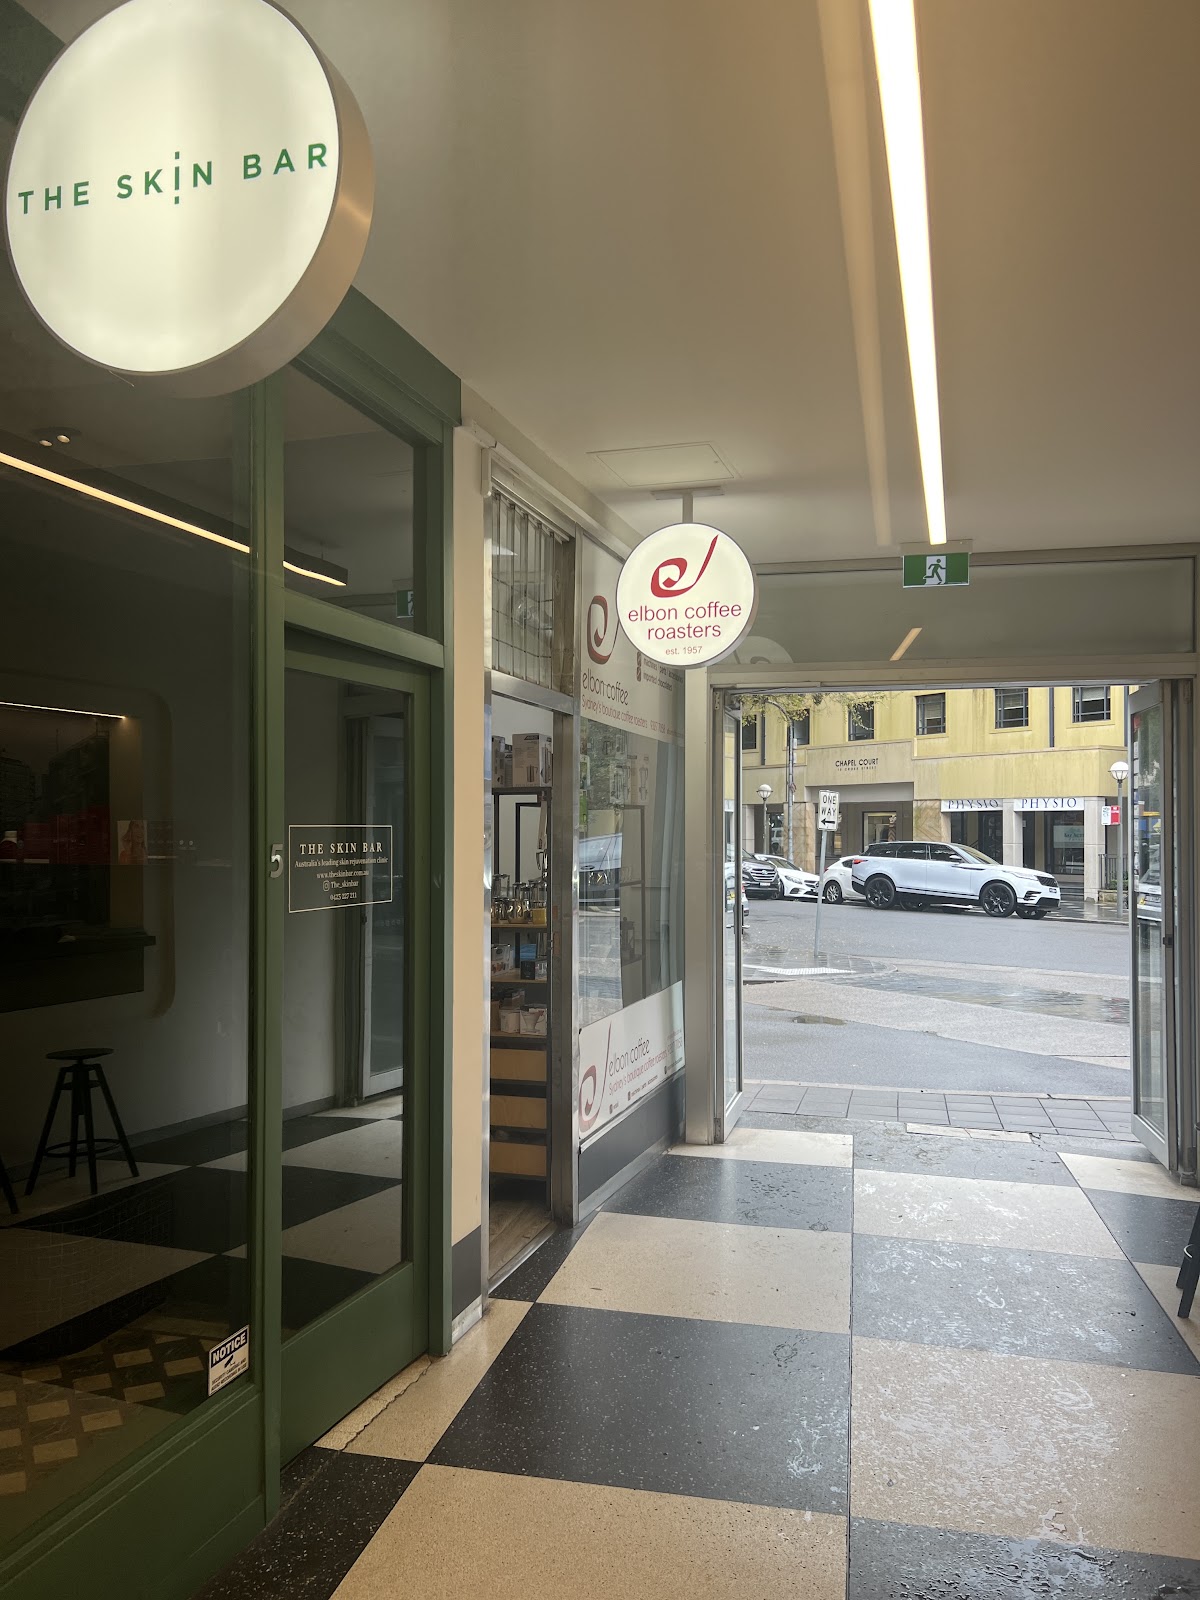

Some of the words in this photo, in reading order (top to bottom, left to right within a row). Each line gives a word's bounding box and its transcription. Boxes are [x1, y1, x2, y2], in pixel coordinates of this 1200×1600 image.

[18, 181, 90, 215] THE
[243, 143, 328, 180] BAR
[628, 605, 678, 622] elbon
[684, 601, 742, 619] coffee
[647, 622, 722, 640] roasters
[665, 647, 681, 656] est.
[683, 645, 703, 654] 1957
[582, 667, 605, 697] elbon
[606, 681, 629, 706] coffee
[835, 759, 856, 767] CHAPEL
[858, 758, 879, 766] COURT
[822, 794, 836, 805] ONE
[948, 799, 999, 809] PHYSIO
[1021, 797, 1077, 809] PHYSIO
[821, 807, 836, 816] WAY
[299, 843, 324, 855] THE
[330, 842, 357, 854] SKIN
[362, 842, 383, 853] BAR
[321, 858, 339, 867] leading
[608, 1052, 629, 1077] elbon
[630, 1037, 650, 1064] coffee
[212, 1332, 246, 1364] NOTICE
